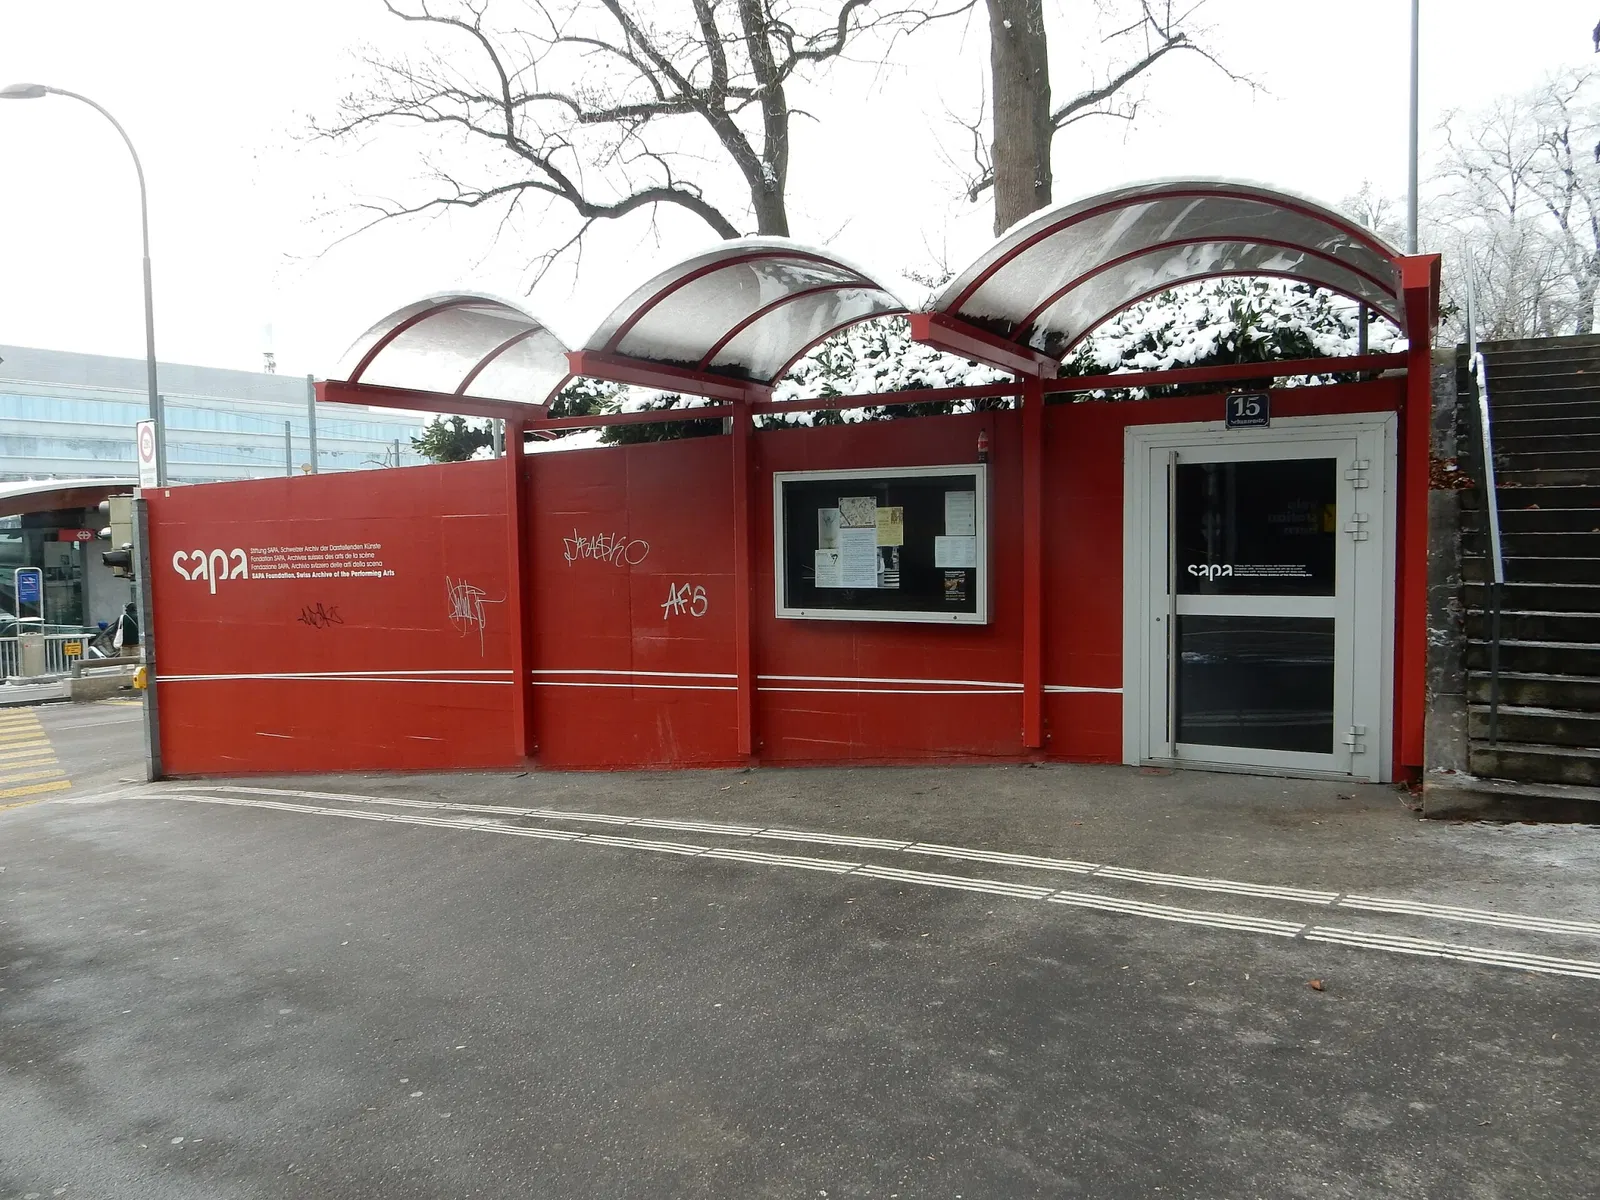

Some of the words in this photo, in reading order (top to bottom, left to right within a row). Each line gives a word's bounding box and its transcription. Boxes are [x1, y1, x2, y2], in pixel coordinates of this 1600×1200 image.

[1233, 396, 1260, 416] 15
[172, 548, 249, 594] sapa
[351, 570, 382, 578] Performing
[1187, 564, 1233, 581] sapa
